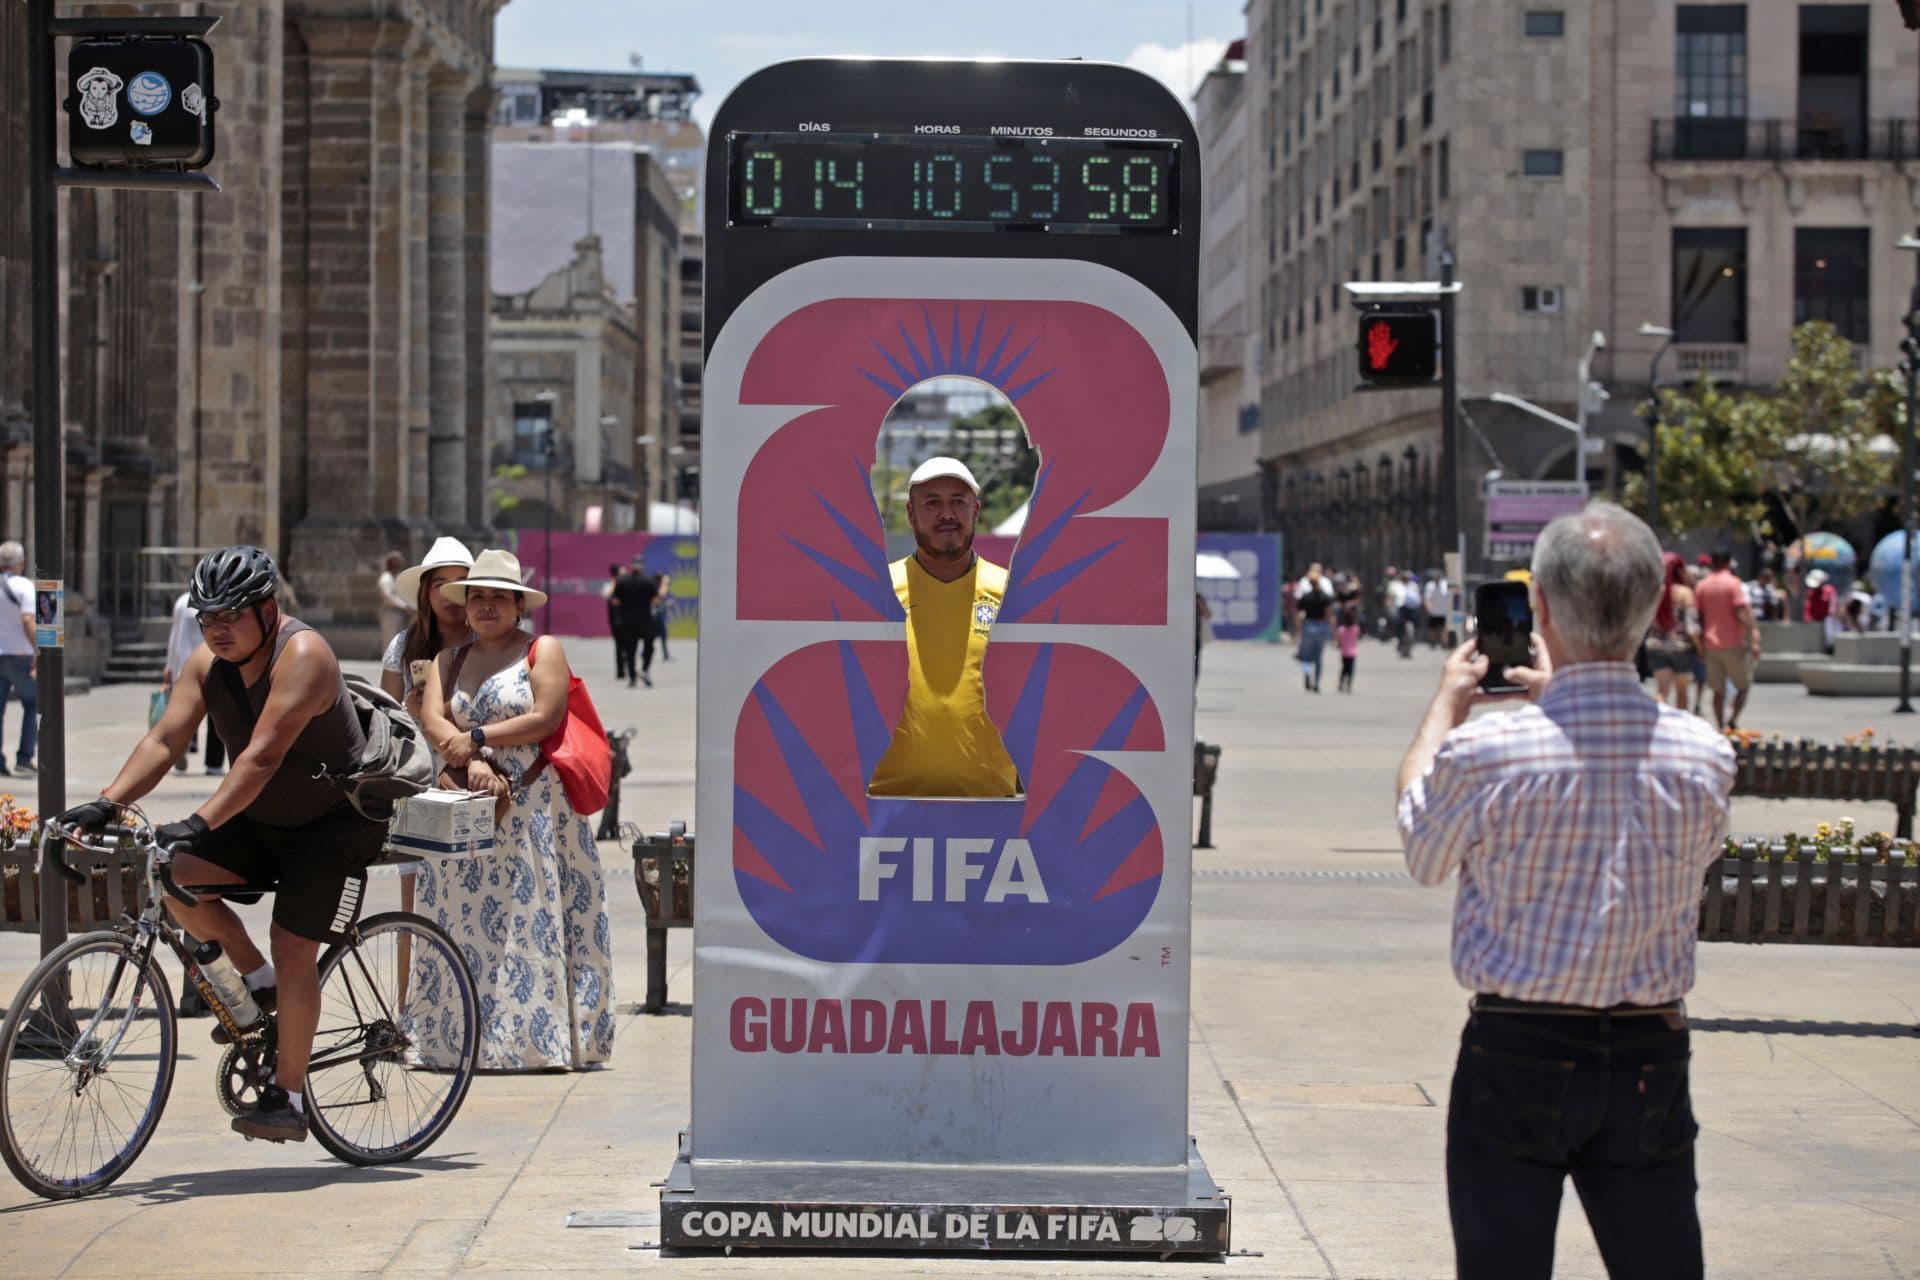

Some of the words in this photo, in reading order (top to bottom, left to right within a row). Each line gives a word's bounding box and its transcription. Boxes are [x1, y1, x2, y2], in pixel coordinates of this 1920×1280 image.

[798, 121, 831, 132] DÍAS
[914, 125, 961, 134] HORAS
[990, 126, 1053, 136] MINUTOS
[1084, 127, 1158, 137] SEGUNDOS
[914, 155, 962, 218] 10
[984, 155, 1060, 219] 53
[1082, 156, 1158, 220] 58
[858, 836, 1050, 905] FIFA
[329, 876, 362, 934] PUMA
[1162, 947, 1170, 967] TM
[730, 996, 1160, 1058] GUADALAJARA
[681, 1211, 775, 1238] COPA
[782, 1211, 938, 1239] MUNDIAL
[945, 1213, 990, 1240] DE
[996, 1214, 1040, 1241] LA
[1047, 1214, 1121, 1242] FIFA
